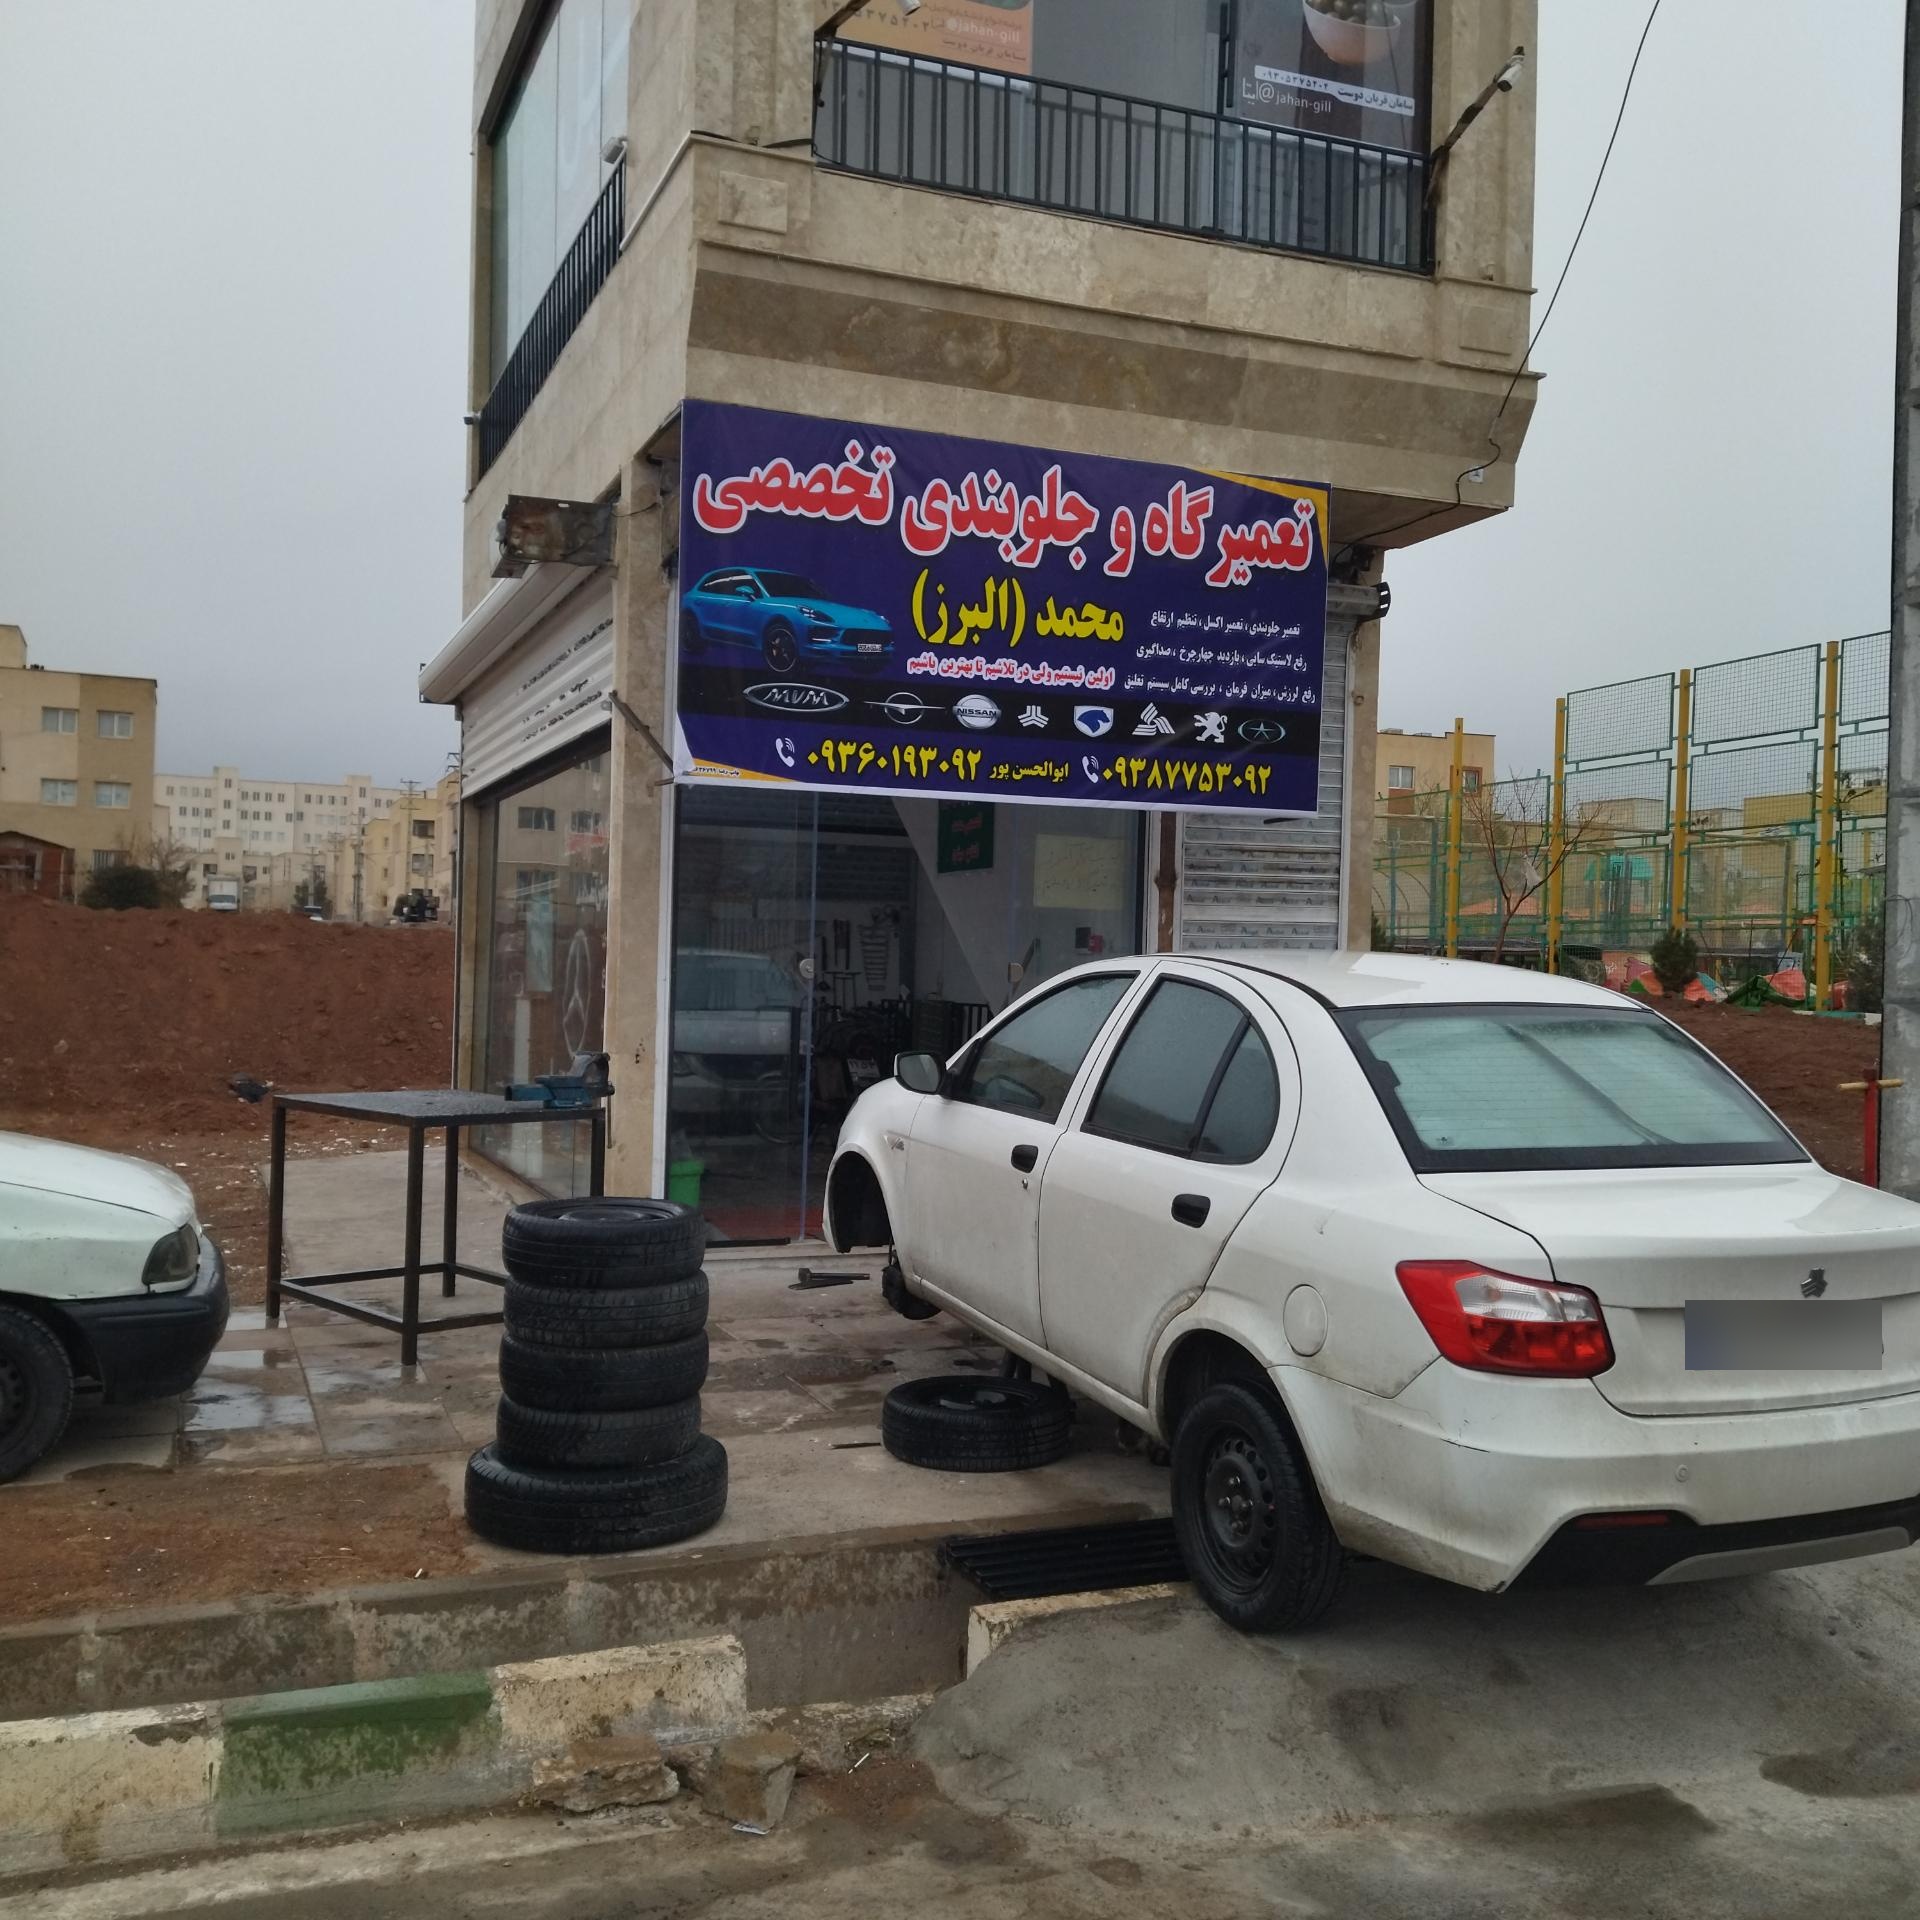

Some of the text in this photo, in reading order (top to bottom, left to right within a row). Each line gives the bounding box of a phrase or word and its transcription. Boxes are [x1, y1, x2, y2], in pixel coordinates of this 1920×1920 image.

[1337, 87, 1364, 101] دوست
[693, 439, 896, 534] تخصصی
[900, 464, 1099, 570] جلوبندی
[1103, 505, 1136, 577] و
[911, 568, 1125, 648] محمد (البرز)
[1150, 610, 1174, 627] ارتفاع
[1176, 613, 1198, 629] تنظیم
[1224, 618, 1244, 634] تعمیر
[1282, 623, 1301, 639] تعمیر
[1136, 642, 1172, 659] صداگیری
[1216, 649, 1240, 666] بازدید
[1266, 652, 1293, 669] لاستیک
[1293, 653, 1307, 672] رفع
[907, 652, 1115, 690] اولین نیستیم ولی در تلاشیم تا بهترین باشیم
[1124, 673, 1145, 690] تعلیق
[1147, 675, 1170, 691] سیستم
[1170, 676, 1190, 693] کامل
[1190, 683, 1216, 696] بررسی
[1250, 684, 1271, 700] میزان
[1301, 687, 1316, 704] رفع
[956, 707, 997, 717] NISSAN
[807, 739, 1272, 795] ۰۹۳۸۷۷۵۳۰۹۲ ابوالحسن پور ۰۹۳۶۰۱۹۳۰۹۲
